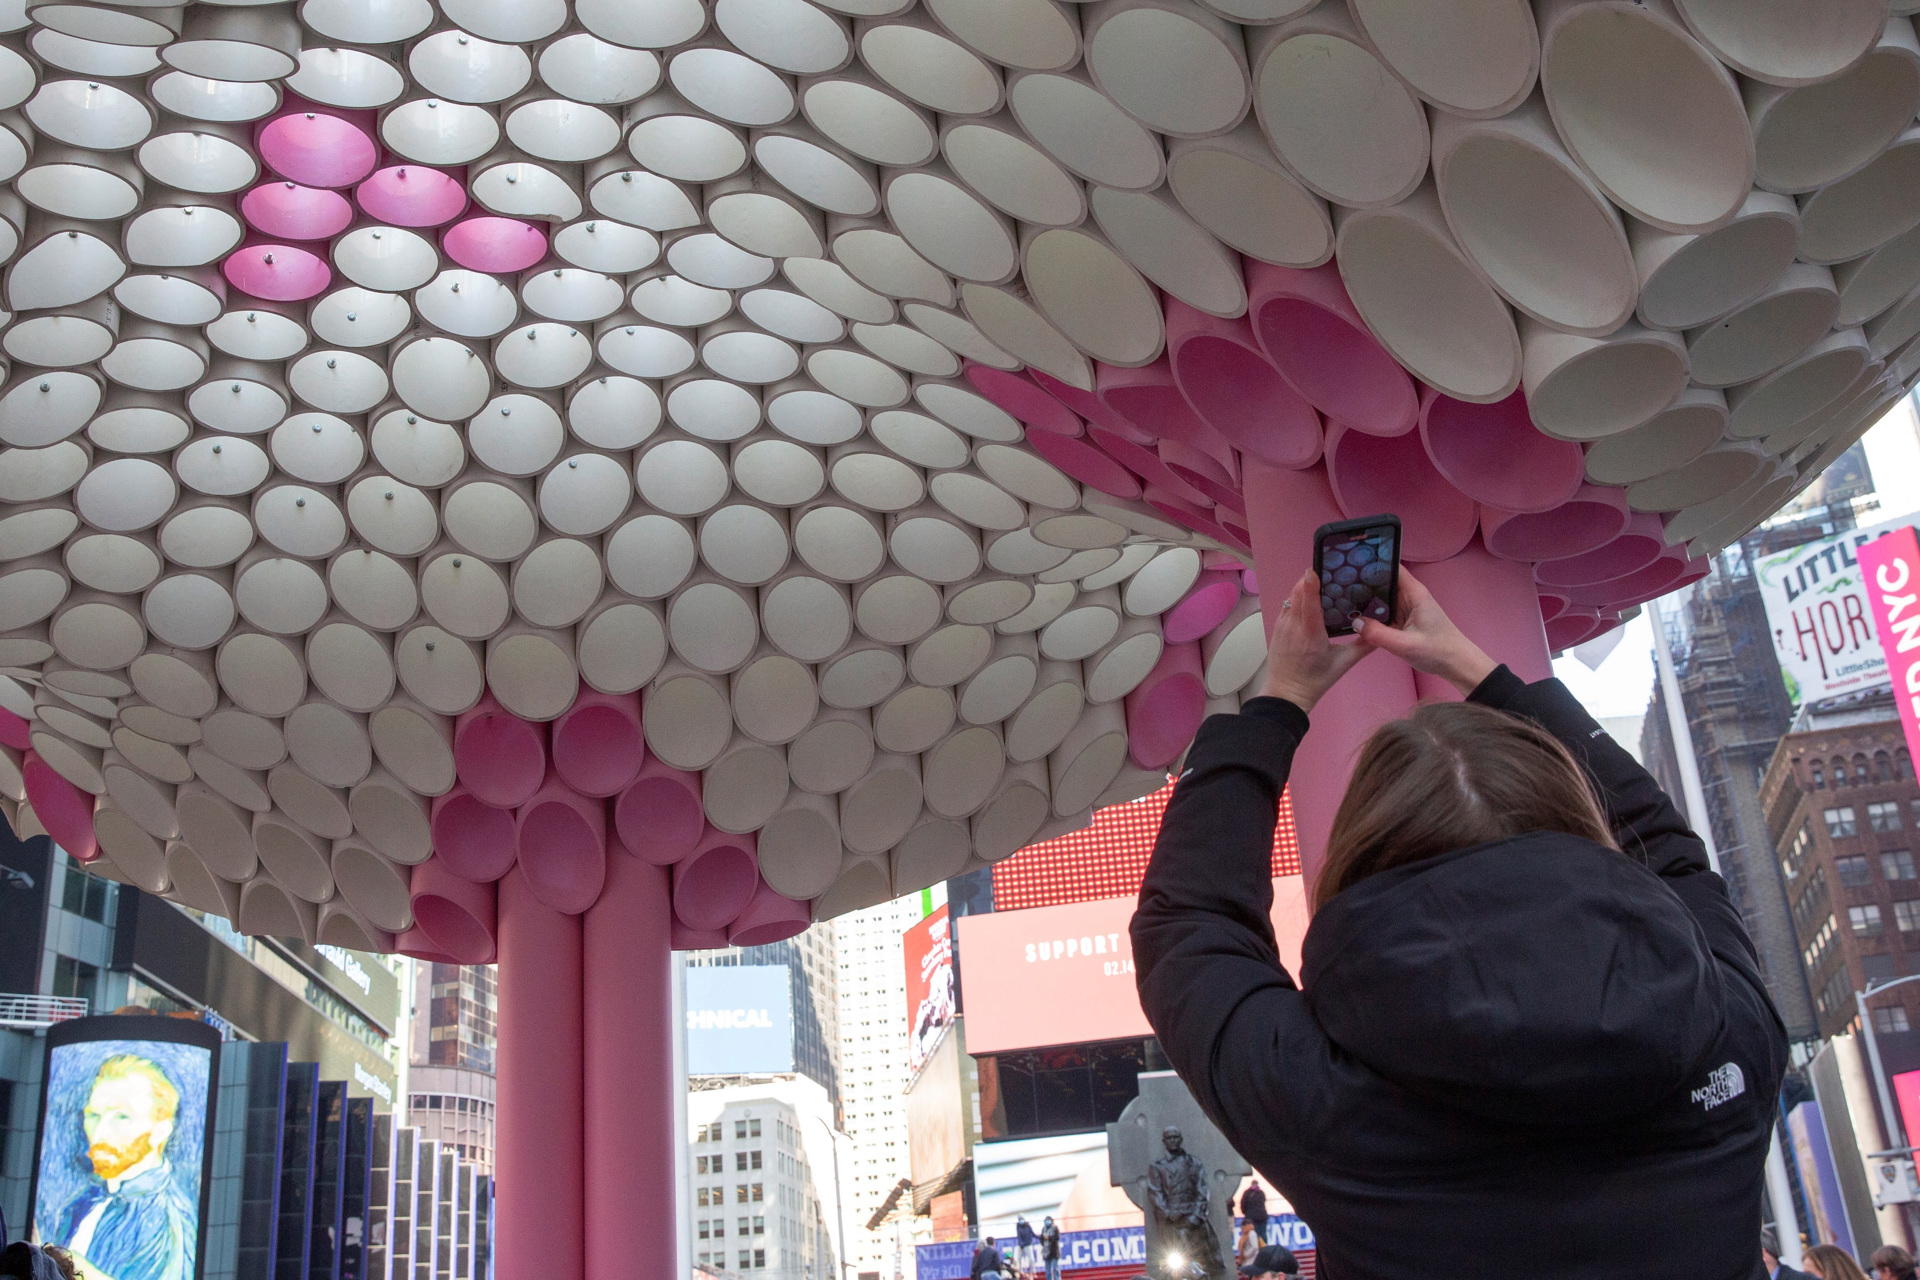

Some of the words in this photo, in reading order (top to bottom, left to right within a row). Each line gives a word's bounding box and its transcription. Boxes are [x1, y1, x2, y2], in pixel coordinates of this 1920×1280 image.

[1876, 557, 1920, 654] NYC
[1025, 933, 1119, 962] SUPPORT
[687, 1009, 773, 1029] HNICAL
[1708, 1065, 1727, 1085] THE
[1691, 1077, 1728, 1103] NORTH
[1704, 1089, 1731, 1111] FACE
[1002, 1235, 1146, 1268] ELCOM
